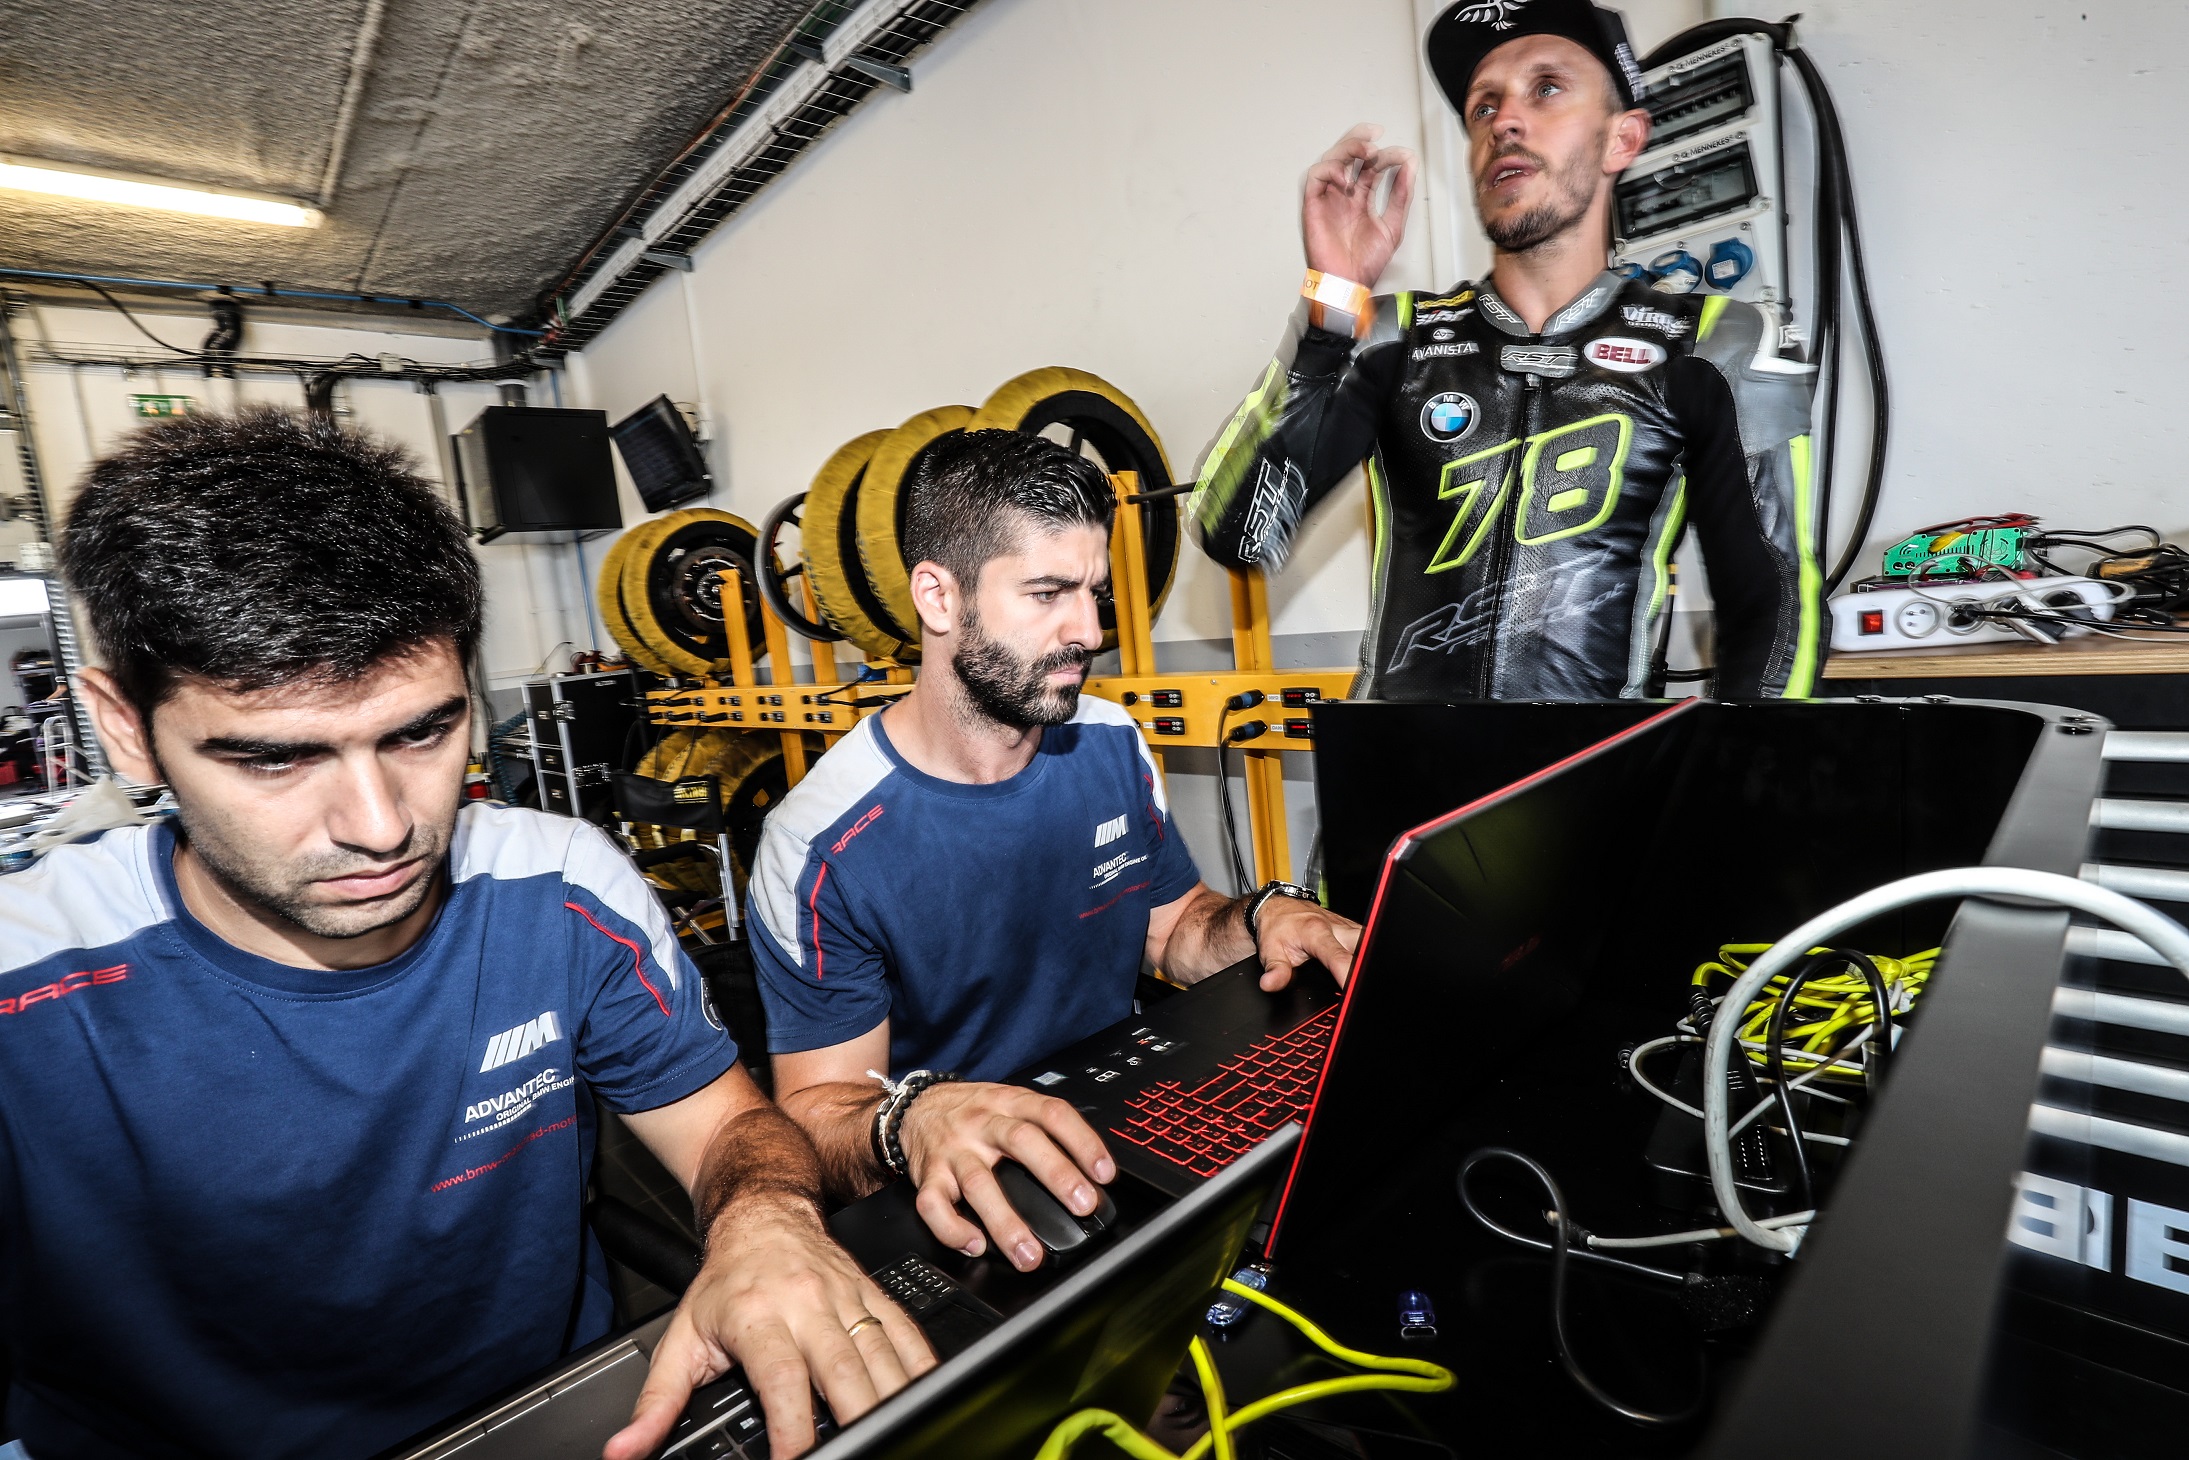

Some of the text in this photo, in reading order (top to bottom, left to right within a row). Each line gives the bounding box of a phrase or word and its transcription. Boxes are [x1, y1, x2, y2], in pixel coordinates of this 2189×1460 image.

[1479, 293, 1522, 324] RST
[1553, 287, 1600, 333] RST
[1591, 342, 1651, 365] BELL
[1427, 394, 1471, 411] BMW
[1424, 413, 1633, 574] 78
[1093, 851, 1128, 879] ADVANTEC
[464, 1068, 559, 1124] ADVANTEC
[495, 1097, 532, 1122] ORIGINAL
[532, 1085, 551, 1101] BMW
